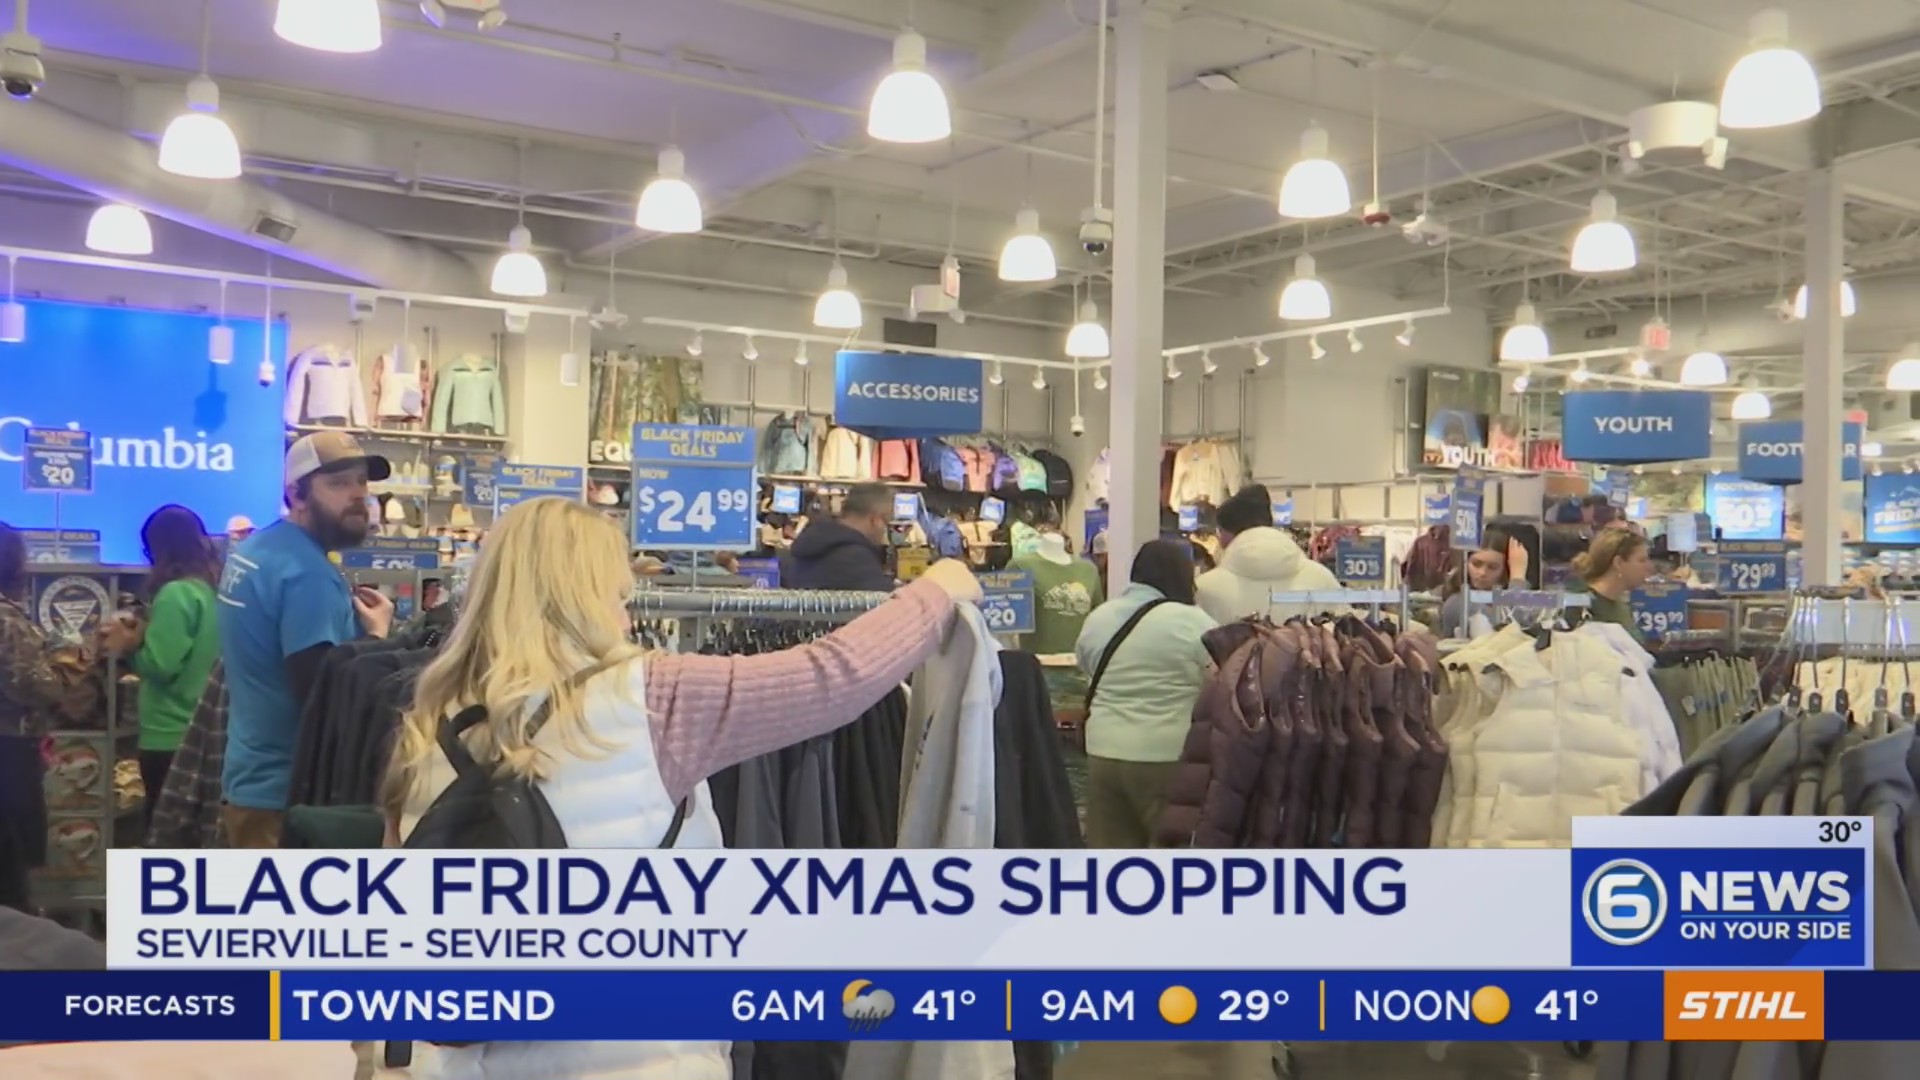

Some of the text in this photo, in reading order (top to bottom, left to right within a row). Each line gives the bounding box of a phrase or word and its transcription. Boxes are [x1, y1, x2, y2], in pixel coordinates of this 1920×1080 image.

[847, 381, 979, 404] ACCESSORIES
[1594, 416, 1673, 434] YOUTH
[0, 416, 235, 472] Cumbia
[641, 427, 745, 444] BLACK FRIDAY
[670, 443, 717, 457] DEALS
[1441, 445, 1497, 468] YOUTH
[639, 468, 670, 480] NOW
